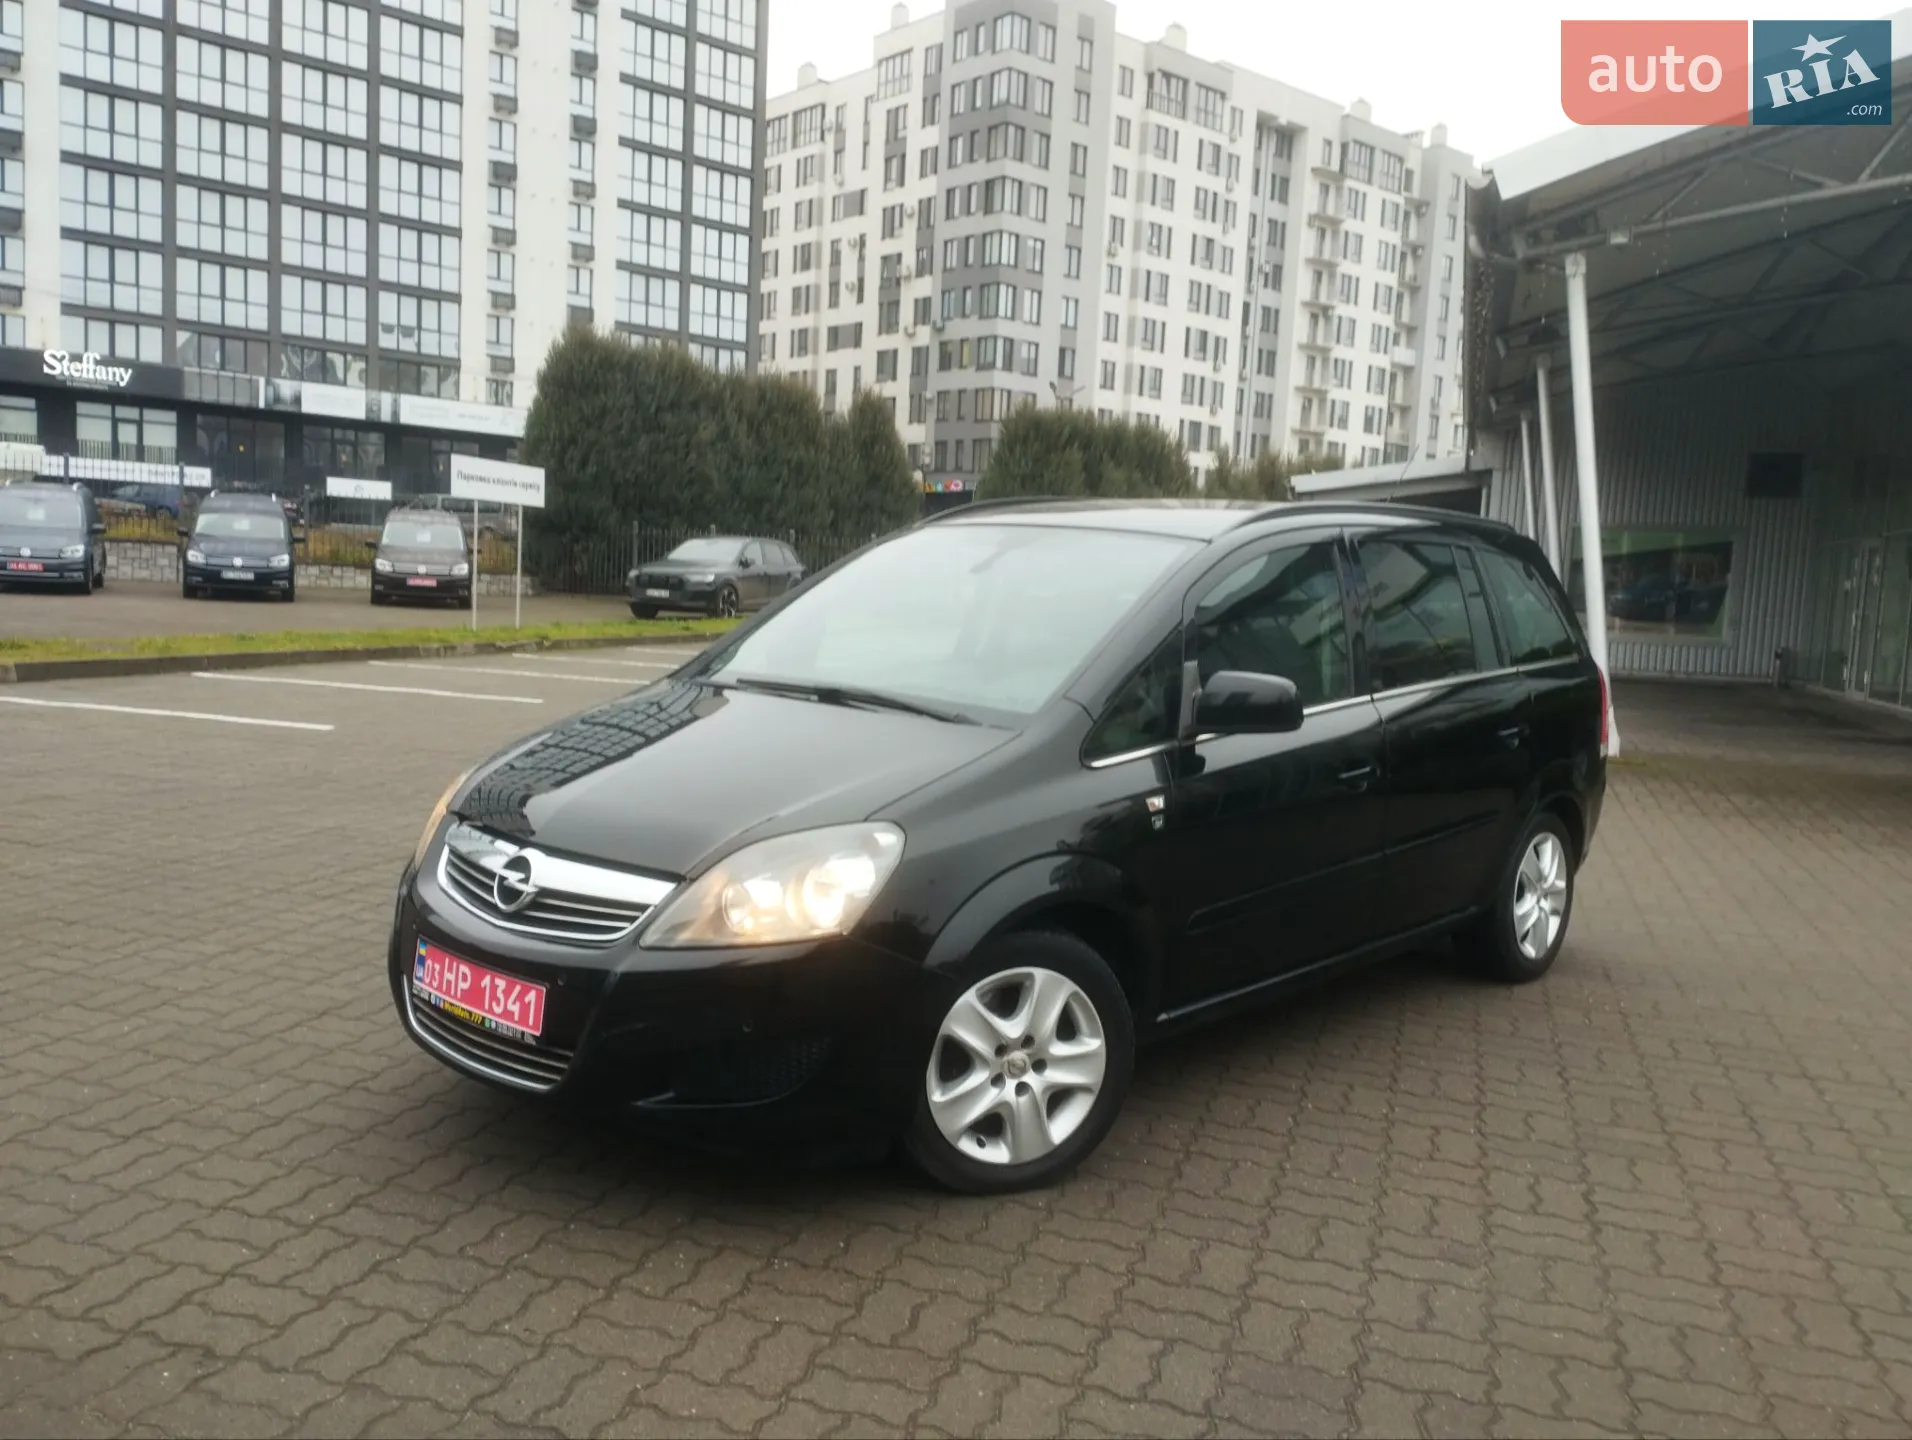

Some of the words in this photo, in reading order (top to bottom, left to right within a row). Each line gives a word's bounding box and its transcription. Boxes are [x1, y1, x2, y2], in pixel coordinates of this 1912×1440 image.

[43, 349, 133, 387] Steffany
[424, 958, 440, 988] 03
[443, 957, 472, 999] HP
[480, 975, 537, 1027] 1341
